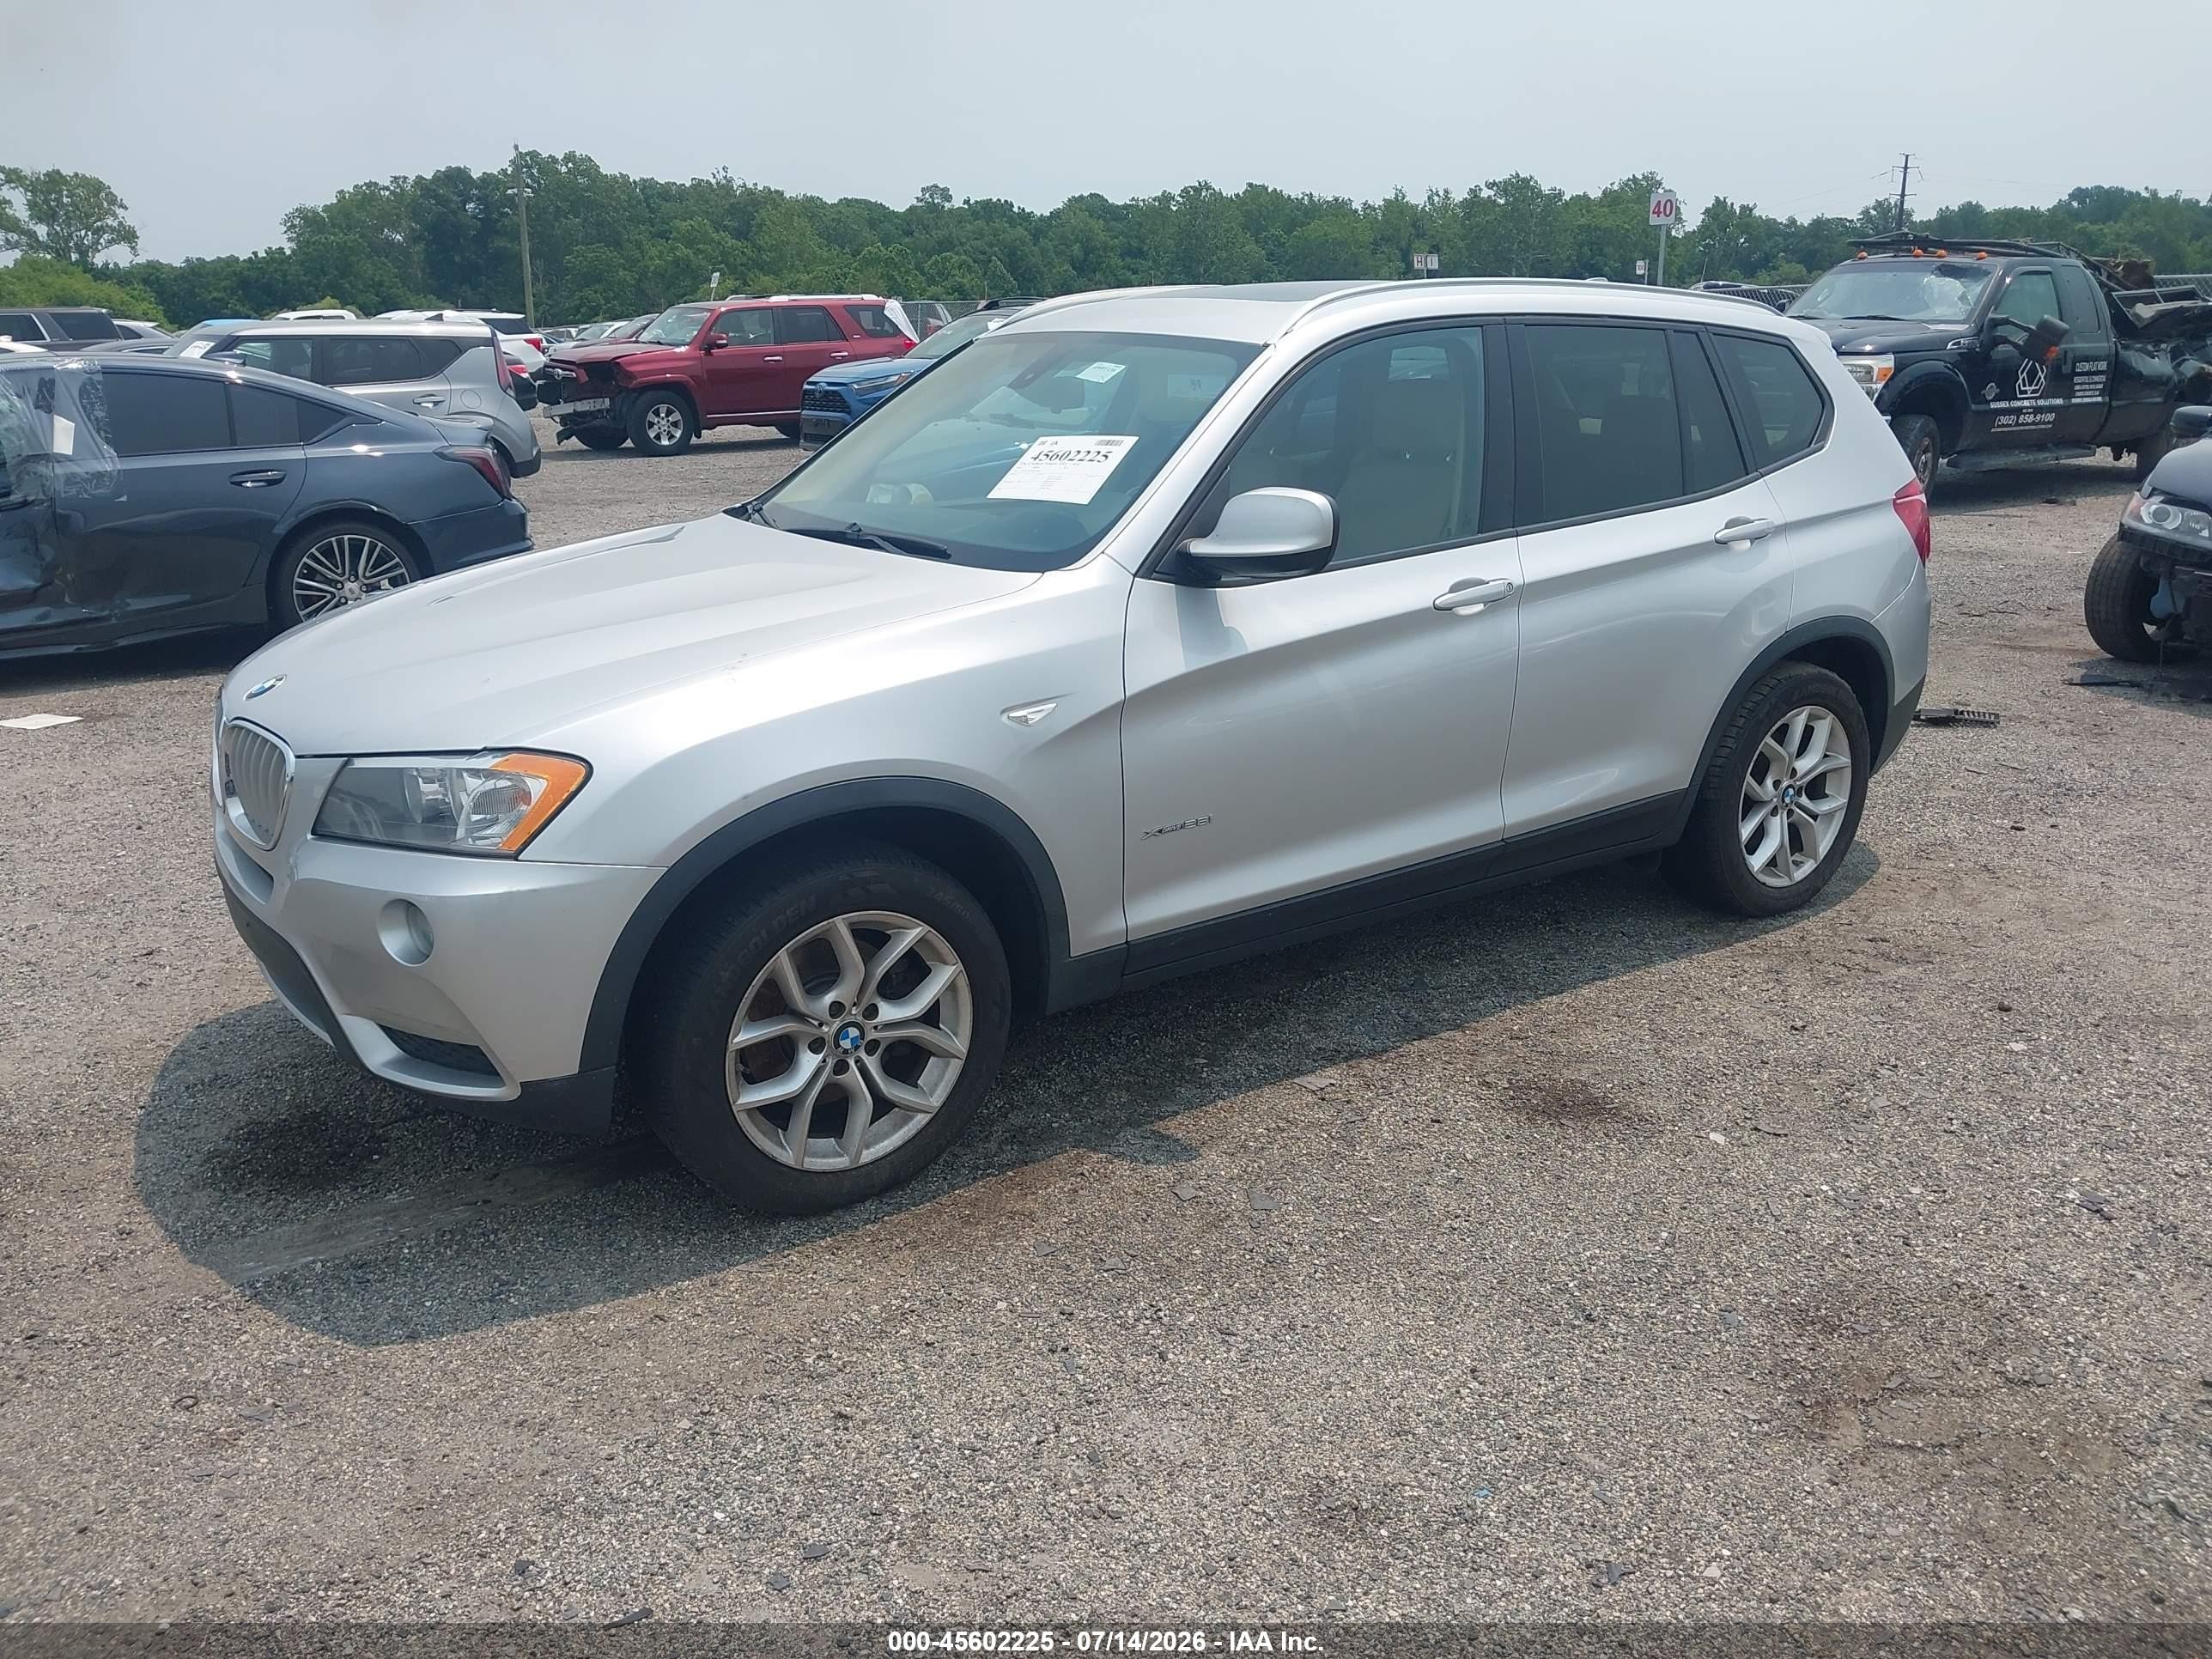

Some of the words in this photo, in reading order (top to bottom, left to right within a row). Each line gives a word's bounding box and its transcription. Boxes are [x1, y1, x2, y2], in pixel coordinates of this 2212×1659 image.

[1651, 198, 1674, 218] 40
[1416, 256, 1423, 267] H
[1990, 400, 2009, 409] SUSSEX
[2036, 398, 2063, 406] SOLUTIONS
[1994, 415, 2017, 428] (302)
[2018, 412, 2056, 423] 858-9100
[1030, 449, 1114, 464] 45602225
